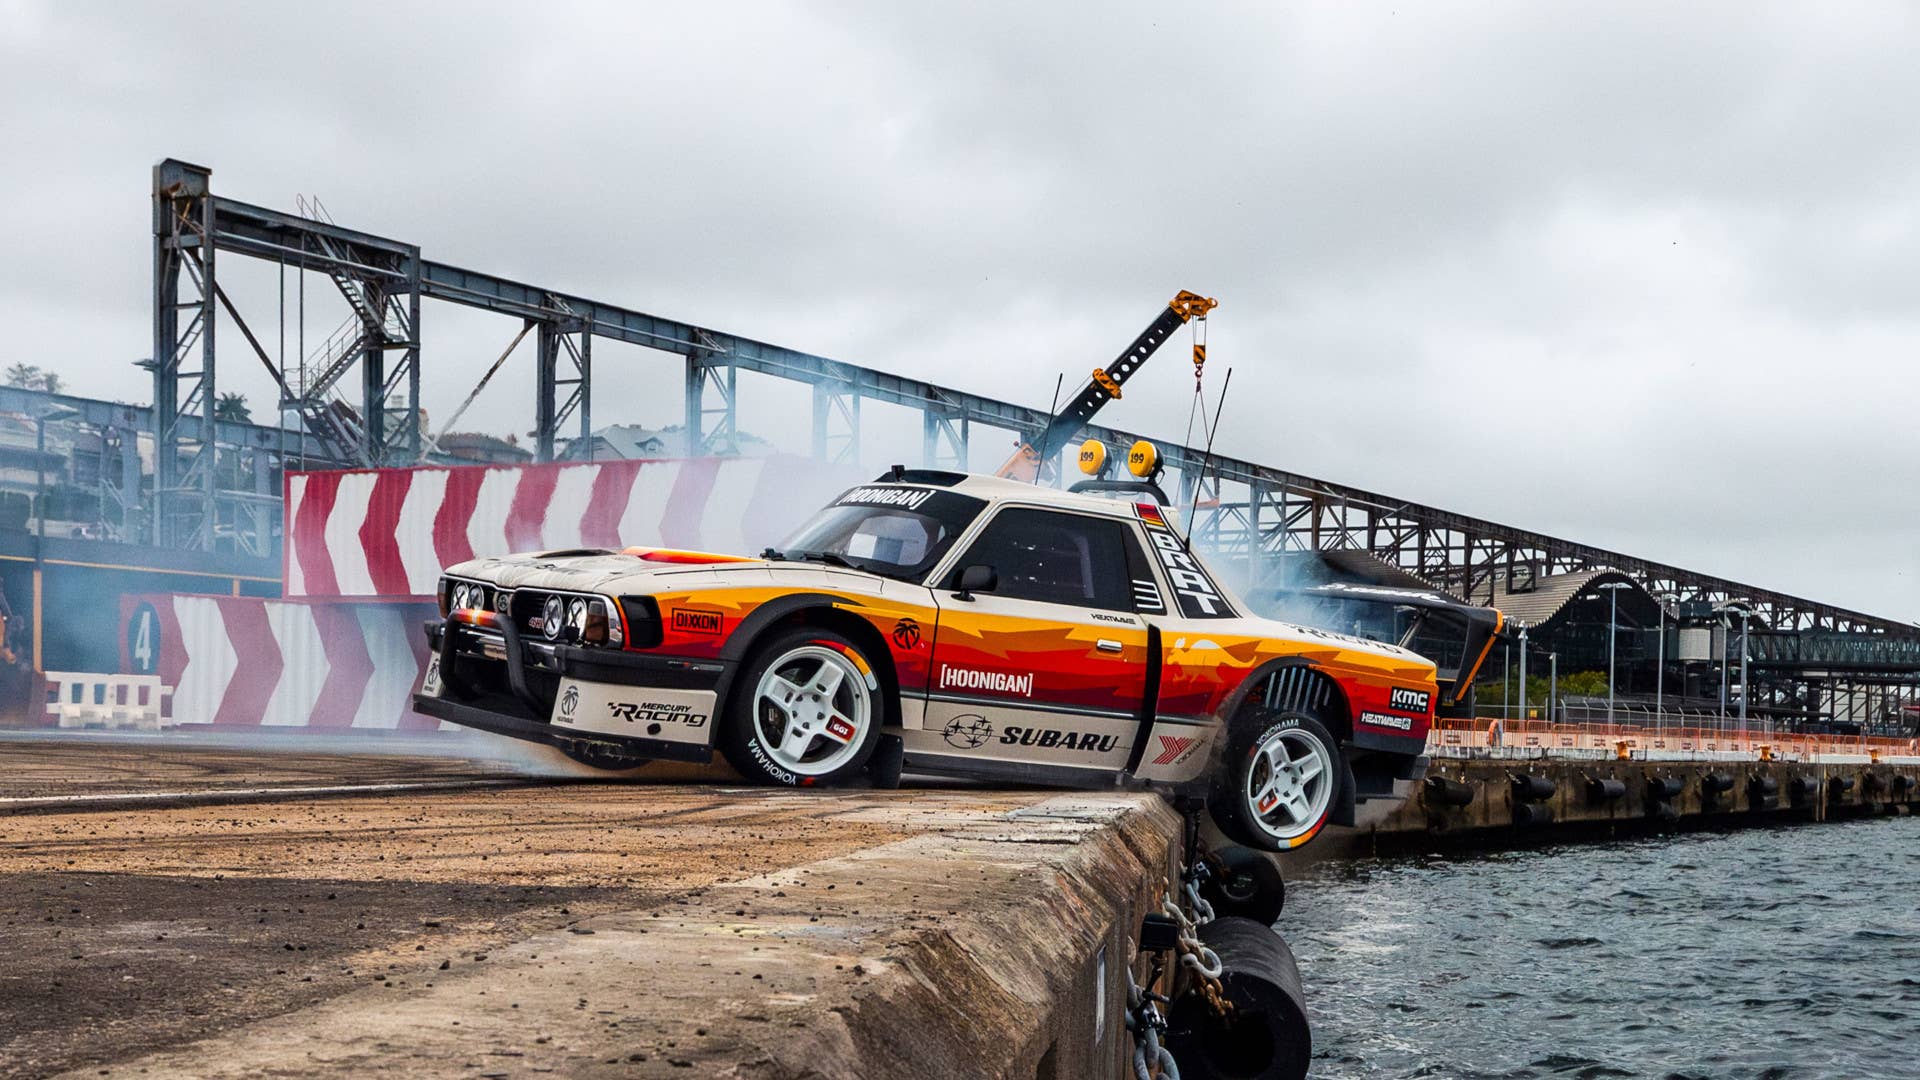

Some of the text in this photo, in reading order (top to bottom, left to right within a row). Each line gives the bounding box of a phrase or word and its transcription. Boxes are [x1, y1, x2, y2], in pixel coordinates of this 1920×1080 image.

[1080, 452, 1094, 461] 199
[1130, 452, 1144, 463] 199
[1150, 531, 1220, 615] BRAT
[676, 612, 719, 630] DIXXON
[135, 611, 151, 670] 4
[611, 702, 707, 727] Racing
[640, 702, 692, 713] MERCURY
[1000, 726, 1119, 752] SUBARU
[1256, 719, 1300, 746] YOKOHAMA
[747, 737, 797, 785] YOKOHAMA
